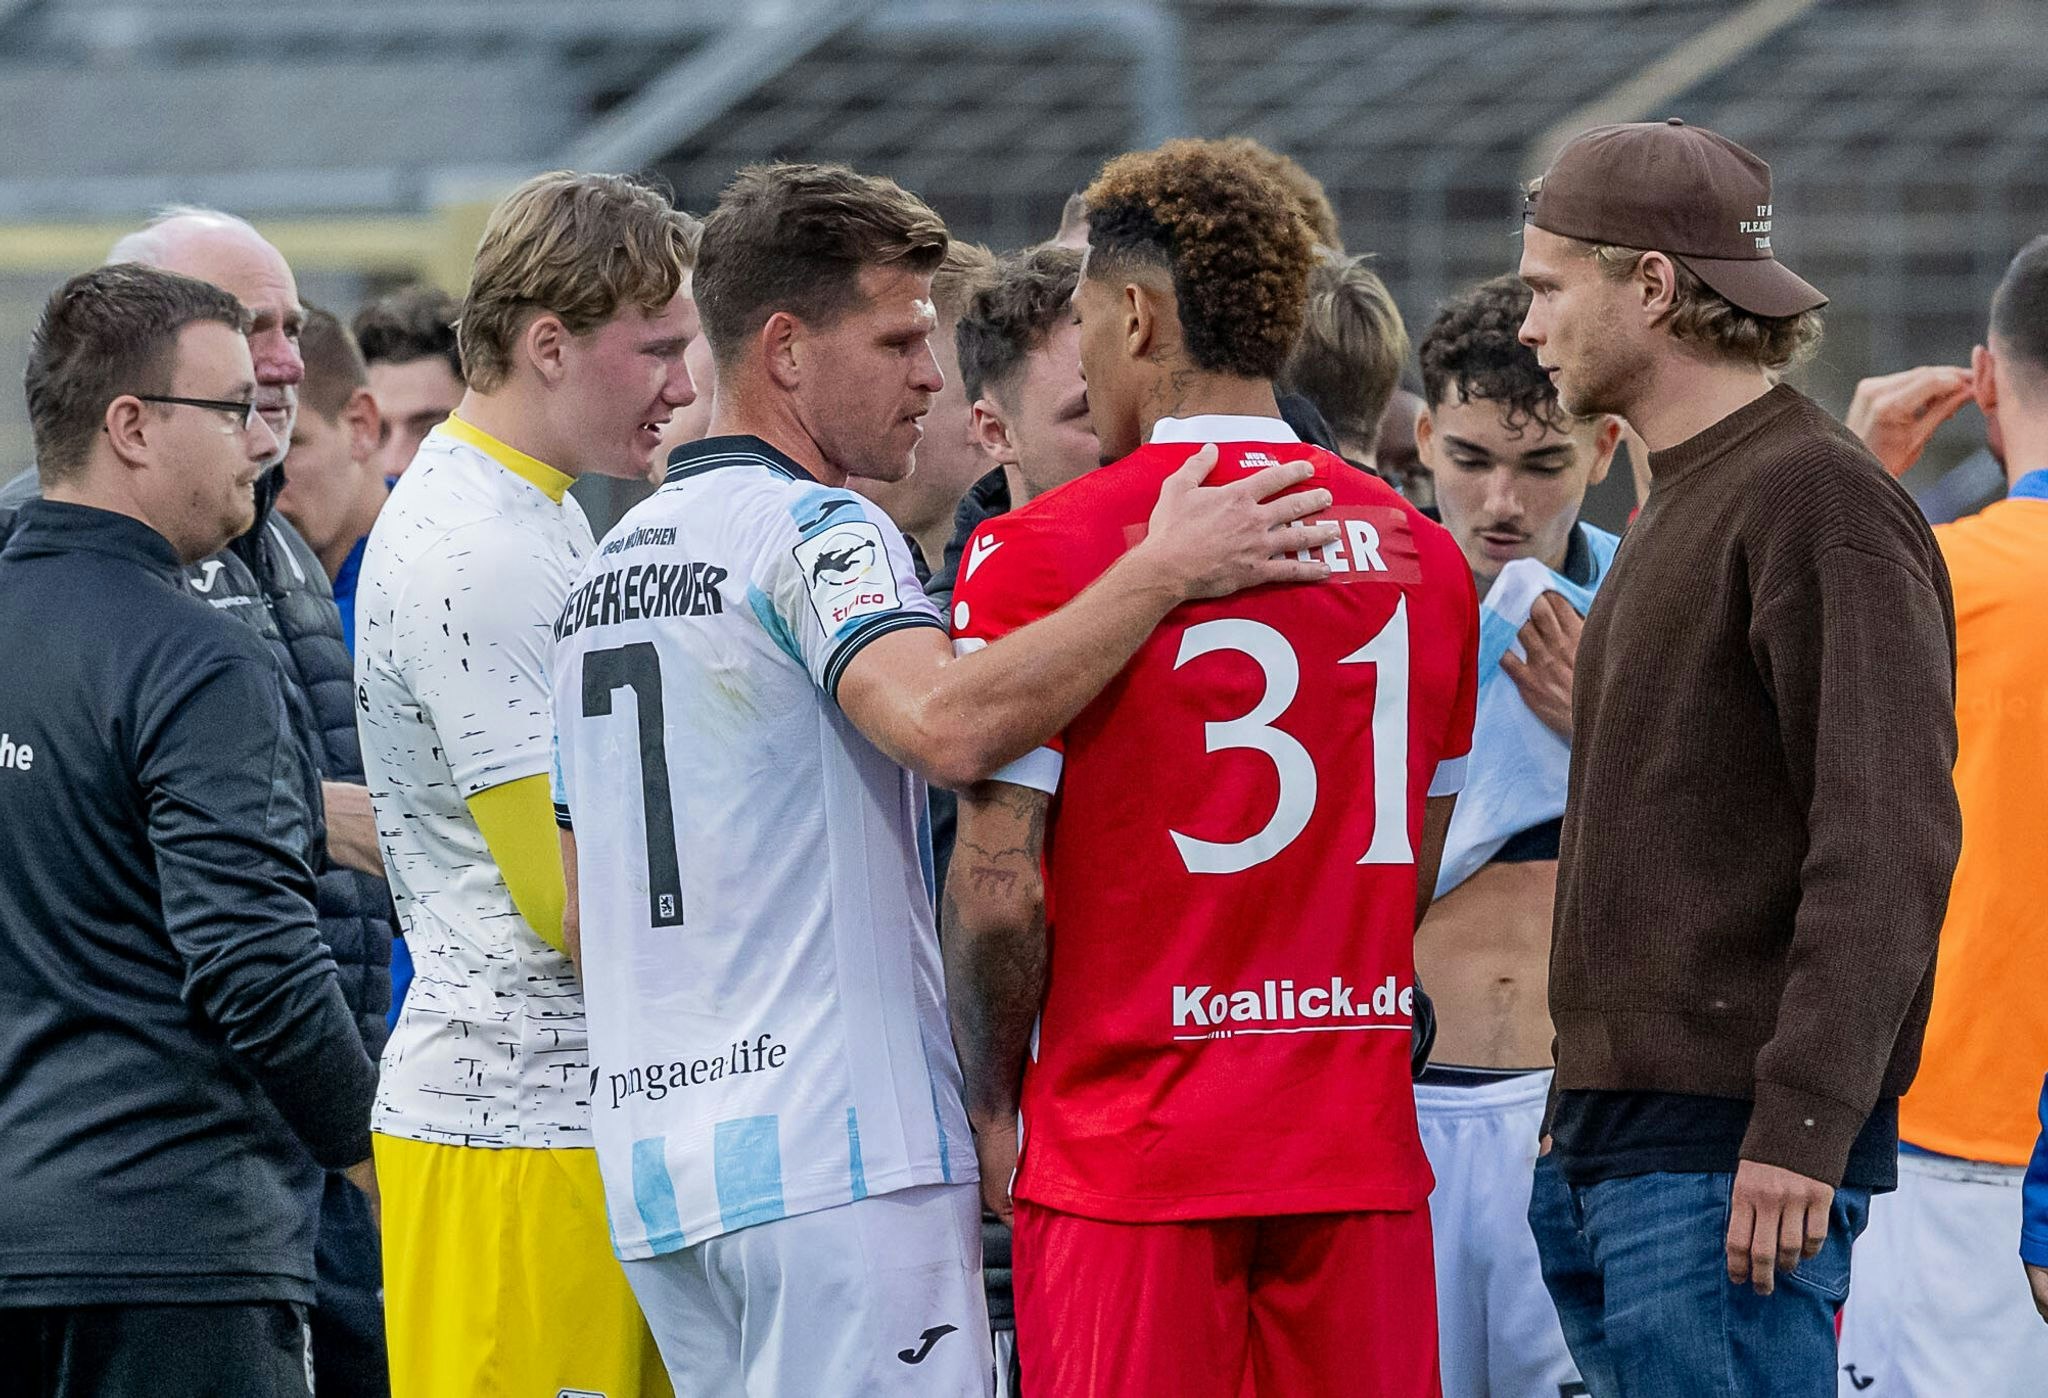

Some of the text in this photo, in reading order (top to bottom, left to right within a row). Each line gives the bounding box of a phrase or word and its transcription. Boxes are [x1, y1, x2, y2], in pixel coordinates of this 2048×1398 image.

[581, 641, 684, 928] 7
[1168, 591, 1415, 874] 31
[1172, 976, 1413, 1027] Koalick.de
